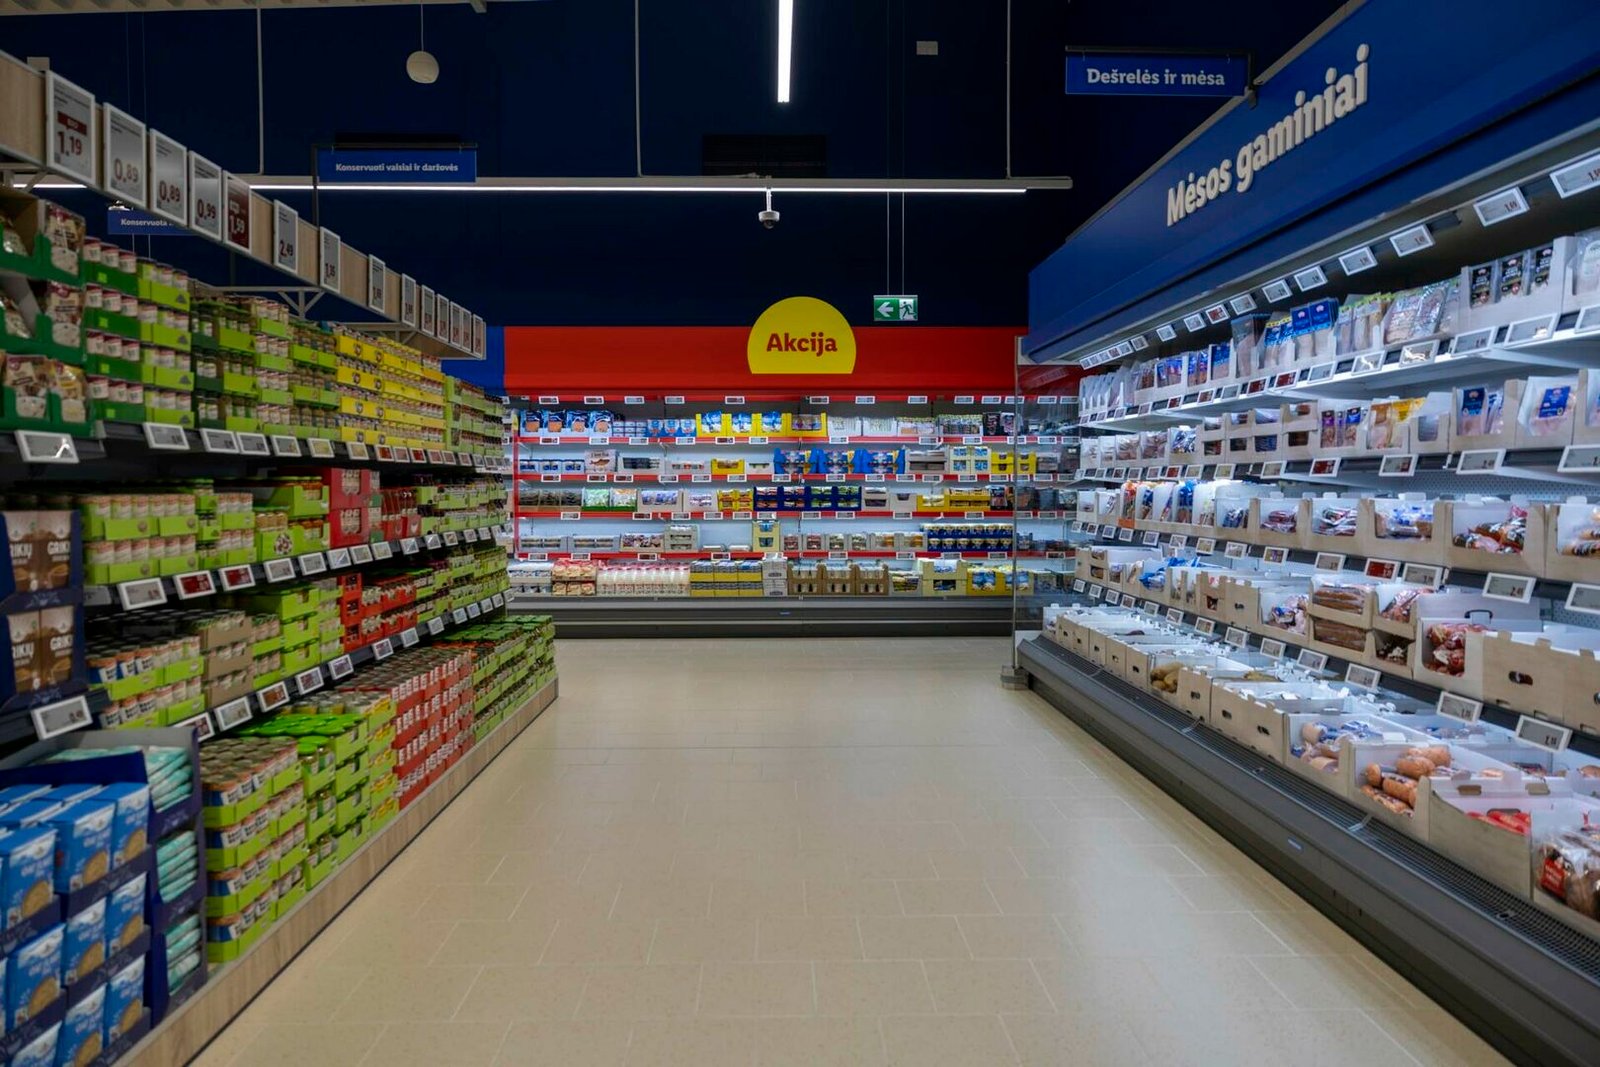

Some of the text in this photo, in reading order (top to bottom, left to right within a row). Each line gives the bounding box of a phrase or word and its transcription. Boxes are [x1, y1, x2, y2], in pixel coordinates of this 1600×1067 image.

[1086, 68, 1226, 86] Dešrelės ir mėsa
[1166, 43, 1370, 227] Mėsos gaminiai
[335, 163, 459, 172] Konservuoti vaisiai ir daržovės
[120, 218, 168, 226] Konservuota
[766, 331, 838, 357] Akcija
